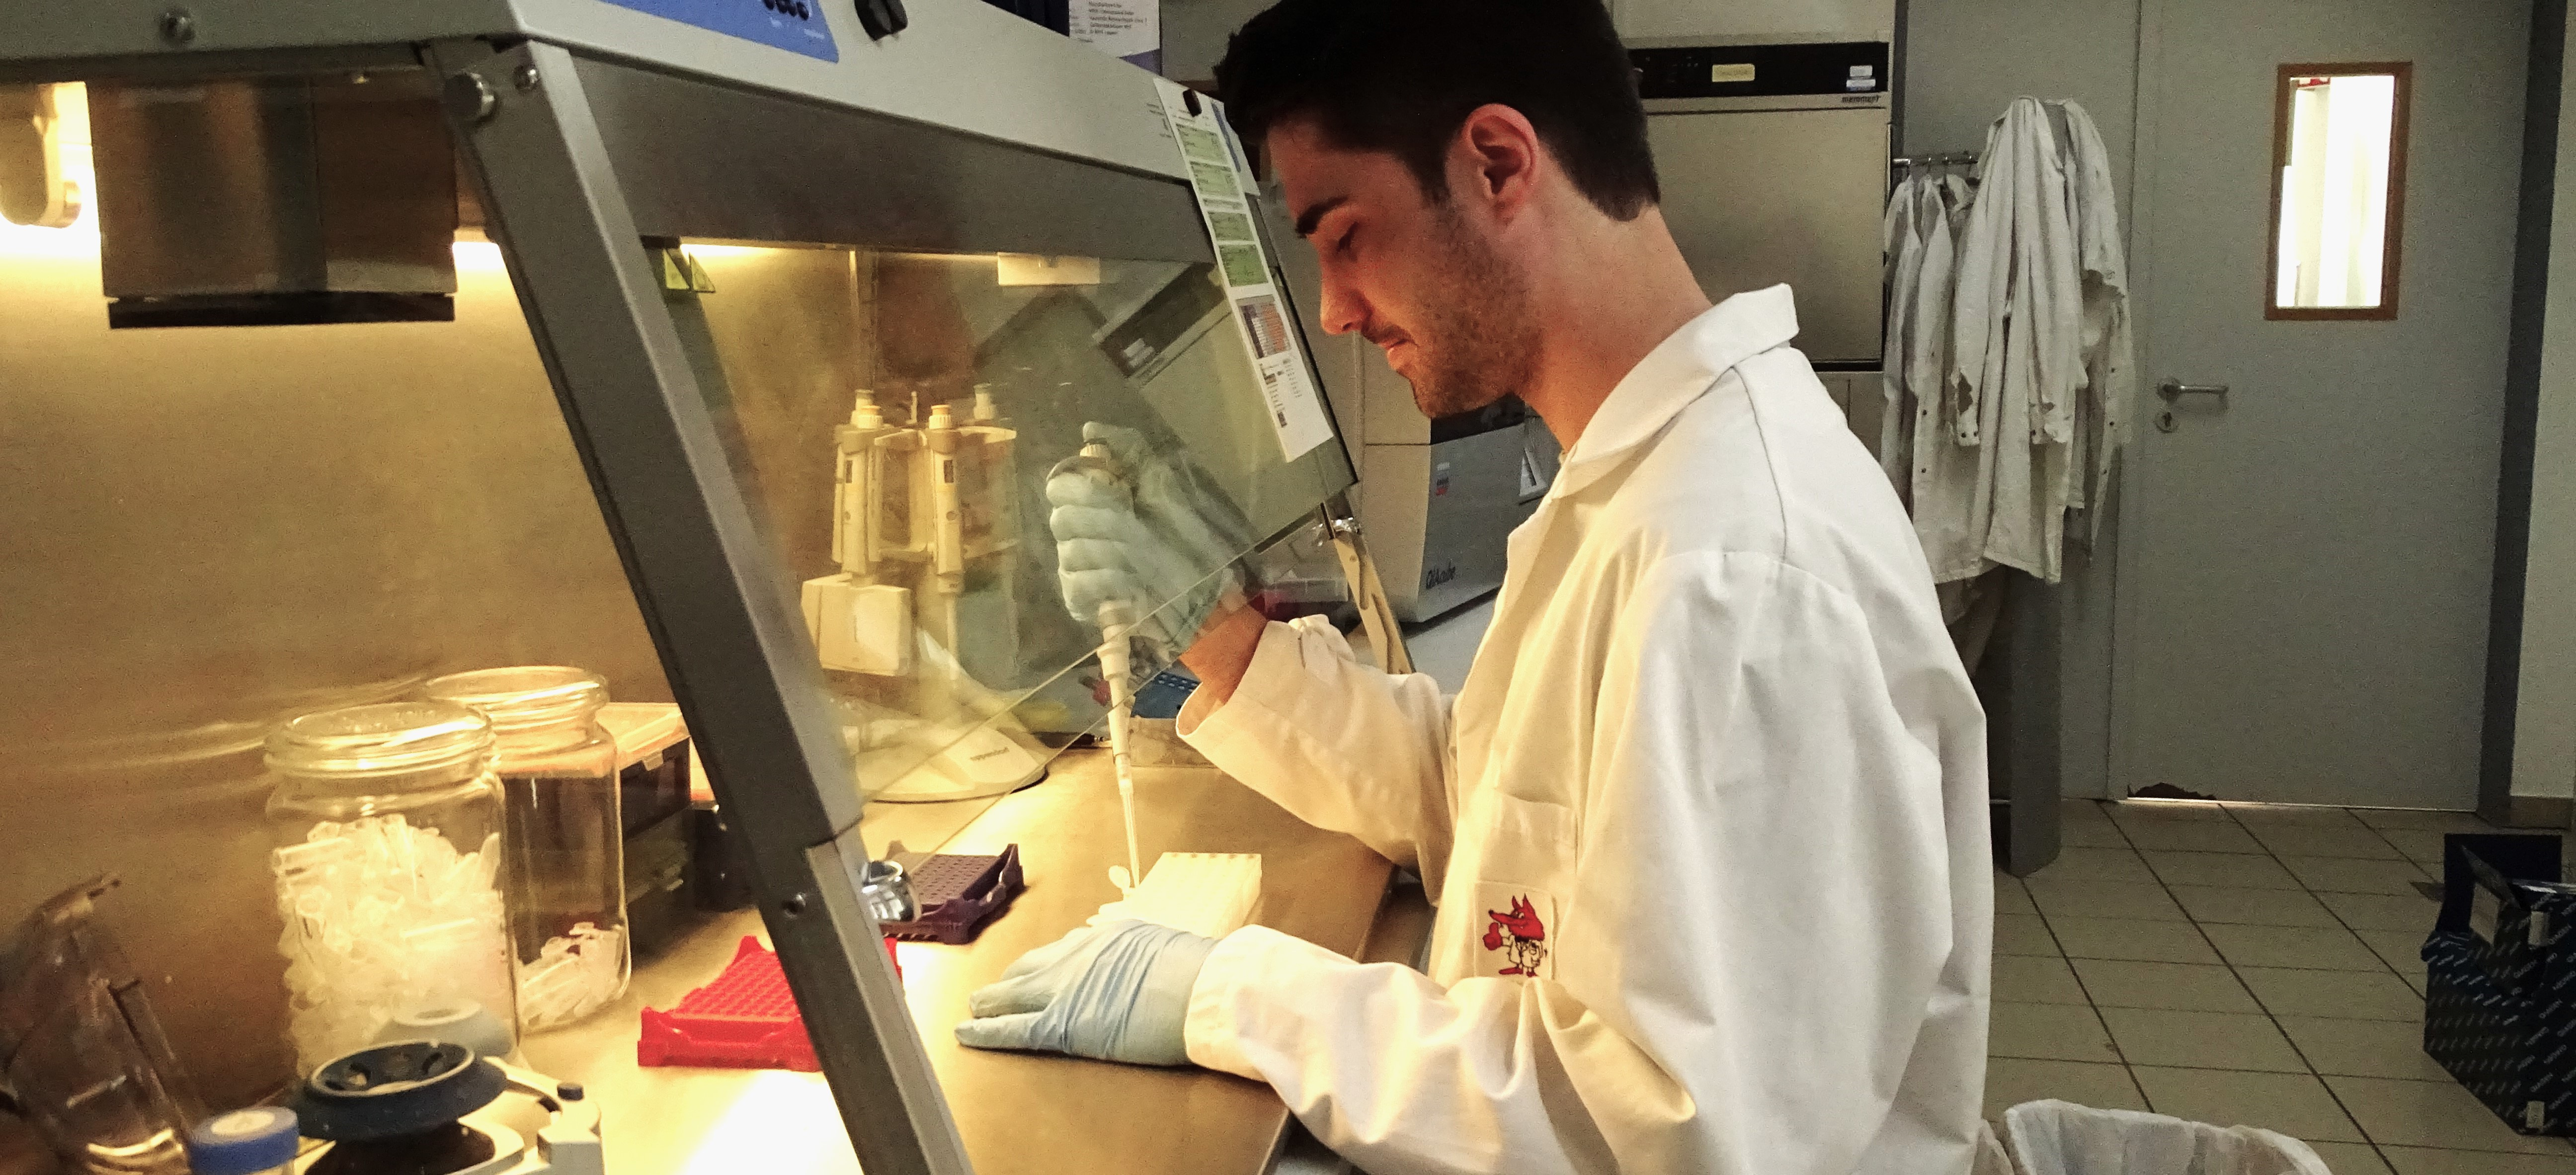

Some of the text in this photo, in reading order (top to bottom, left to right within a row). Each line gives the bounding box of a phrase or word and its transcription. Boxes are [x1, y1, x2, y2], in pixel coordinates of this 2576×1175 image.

[2548, 923, 2573, 945] QIAGEN
[2513, 959, 2538, 979] QIAGEN
[2524, 1026, 2550, 1047] QIAGEN
[2543, 1044, 2568, 1064] QIAGEN
